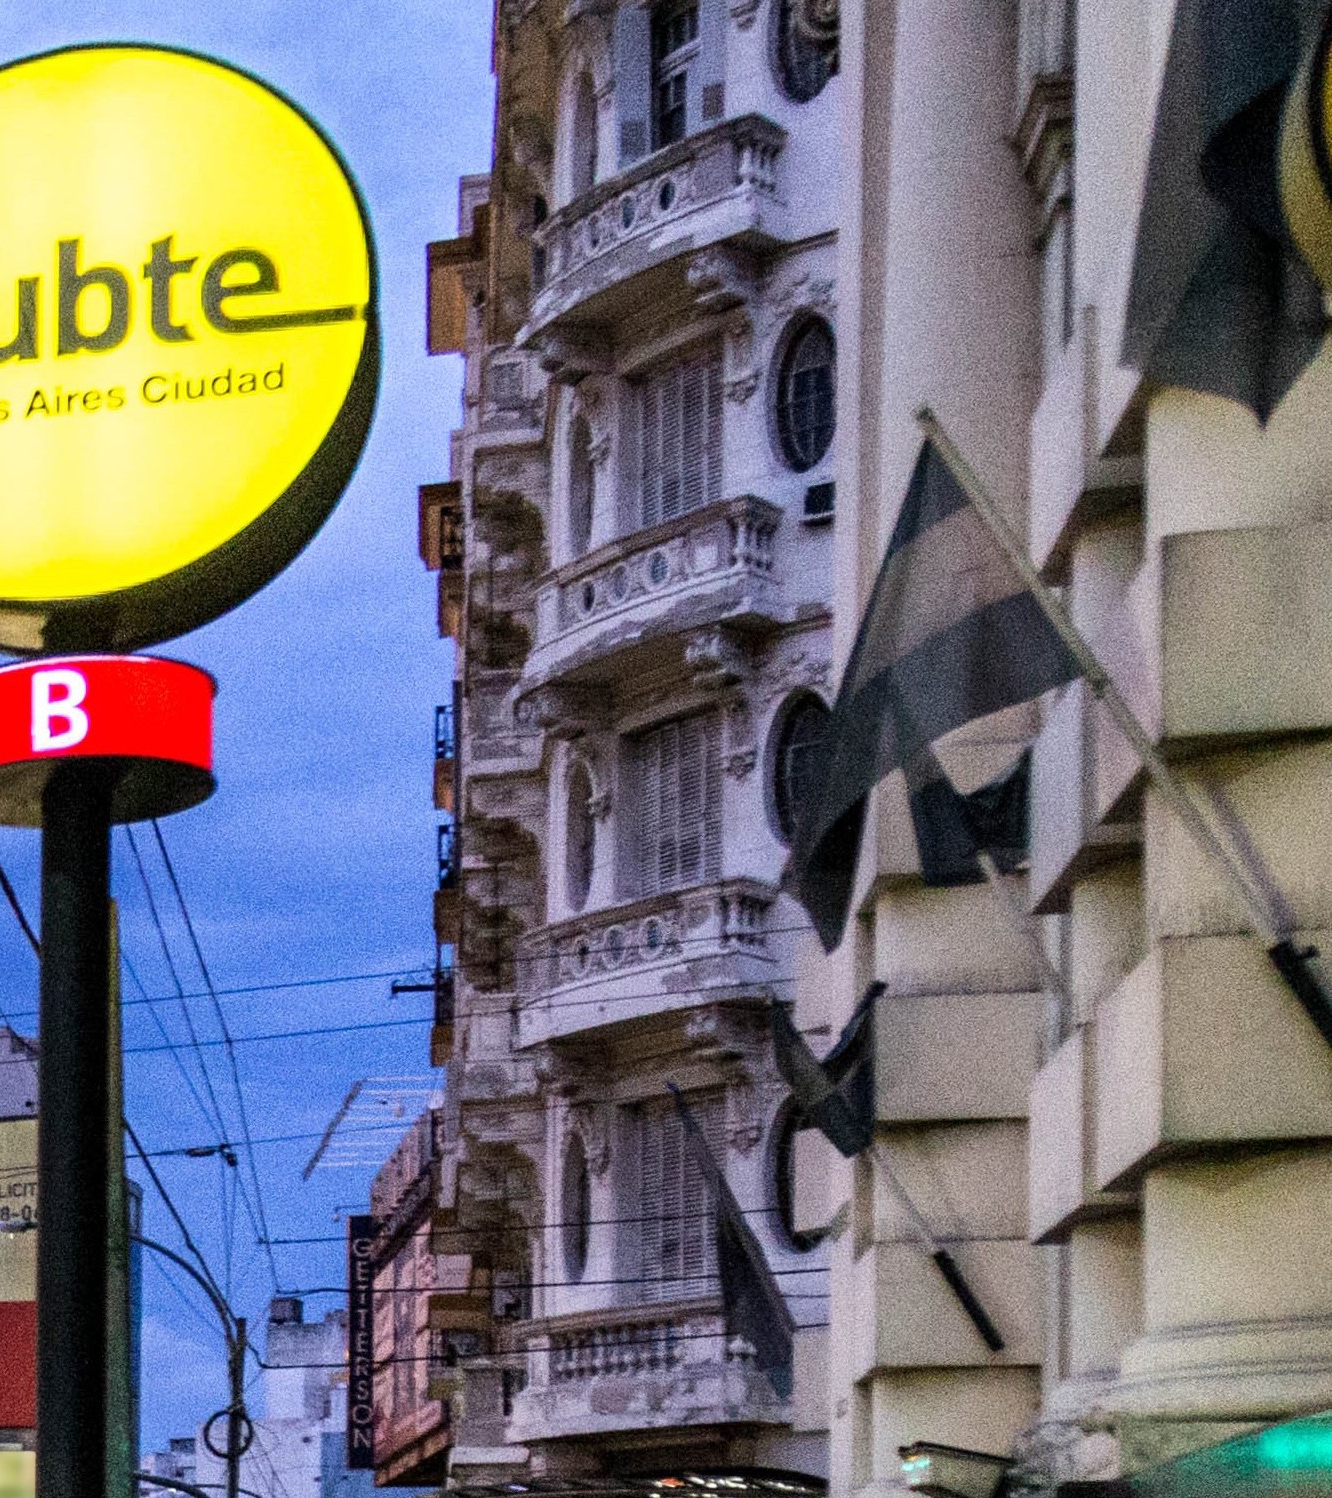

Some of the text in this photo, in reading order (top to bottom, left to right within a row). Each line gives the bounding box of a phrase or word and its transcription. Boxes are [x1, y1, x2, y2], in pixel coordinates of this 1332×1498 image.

[26, 388, 125, 418] Aires
[141, 361, 287, 405] Ciudad
[30, 668, 90, 753] B
